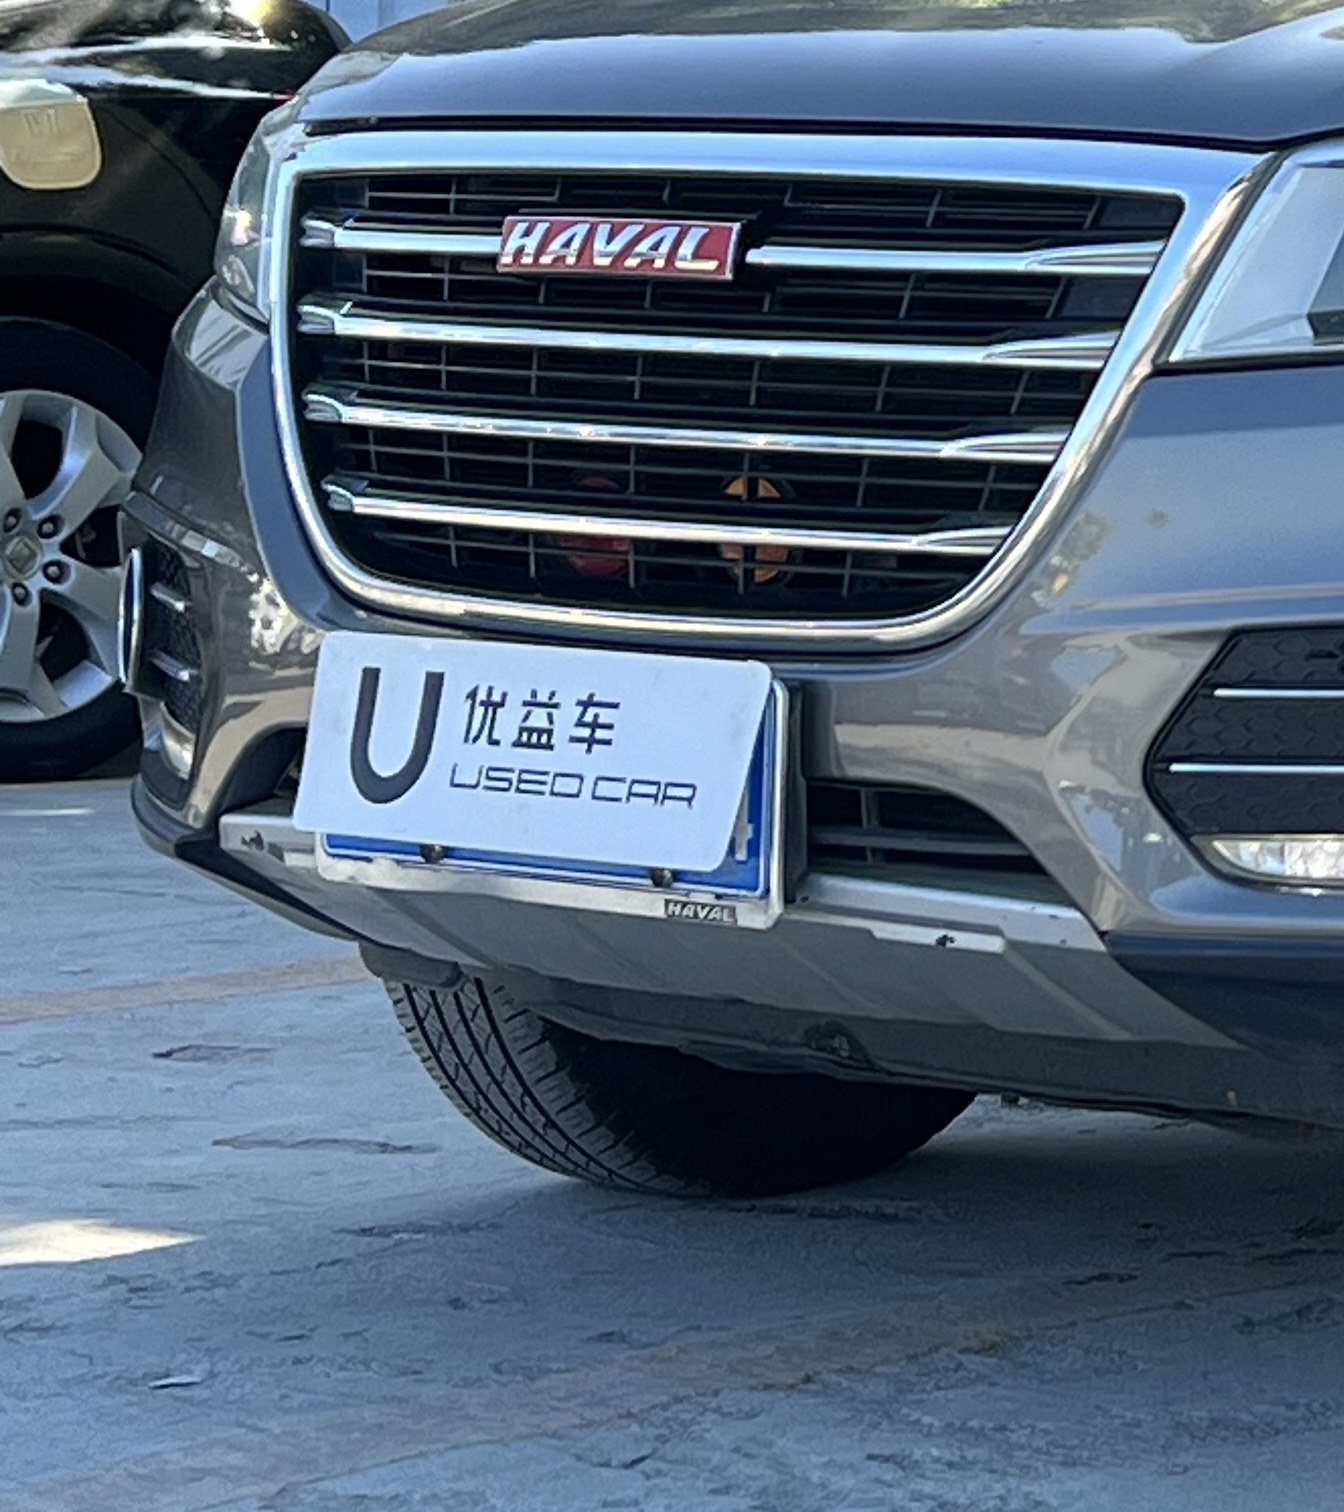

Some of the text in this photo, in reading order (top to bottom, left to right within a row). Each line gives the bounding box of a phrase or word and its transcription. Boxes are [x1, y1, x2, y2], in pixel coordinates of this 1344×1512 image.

[500, 221, 719, 270] HAVAL
[350, 666, 446, 805] U
[464, 685, 620, 754] 优益车
[450, 764, 698, 808] USED CAR
[667, 901, 734, 922] HAVAL
